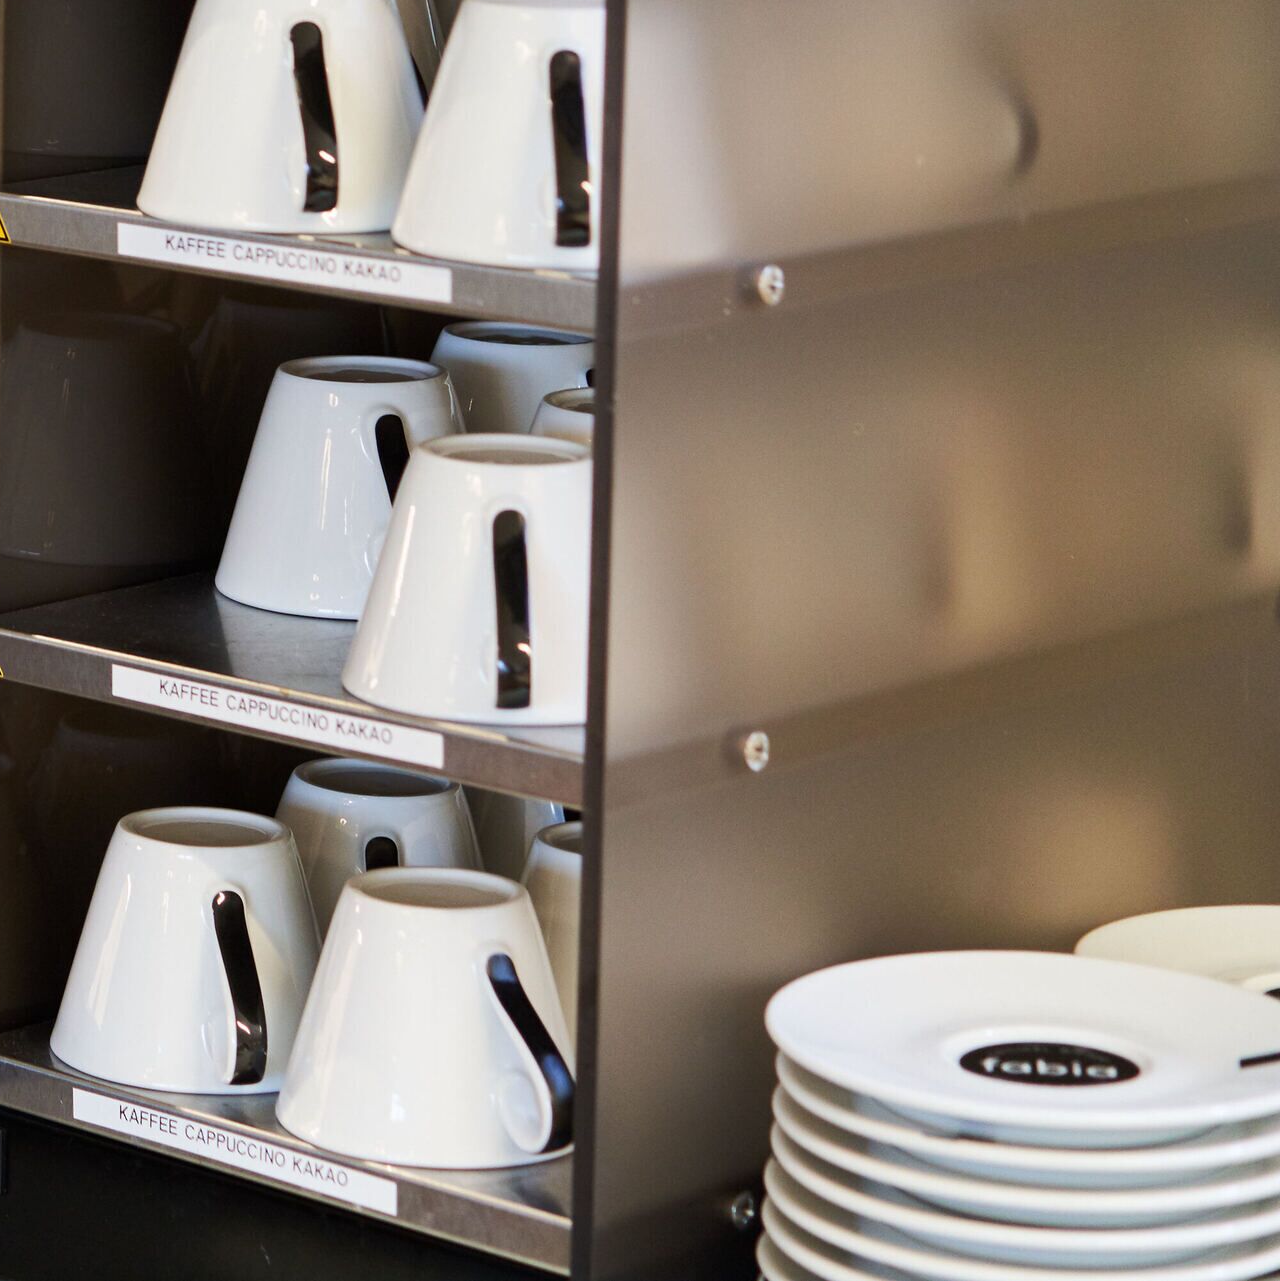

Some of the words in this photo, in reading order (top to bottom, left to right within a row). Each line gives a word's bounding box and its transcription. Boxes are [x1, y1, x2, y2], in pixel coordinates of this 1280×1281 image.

[165, 234, 225, 259] KAFFEE
[233, 243, 337, 275] CAPPUCCINO
[344, 261, 402, 283] KAKAO
[159, 679, 219, 707] KAFFEE
[226, 694, 329, 730] CAPPUCCINO
[335, 720, 393, 744] KAKAO
[982, 1055, 1119, 1079] fabia
[118, 1105, 178, 1136] KAFFEE
[184, 1124, 286, 1168] CAPPUCCINO
[292, 1154, 349, 1187] KAKAO
